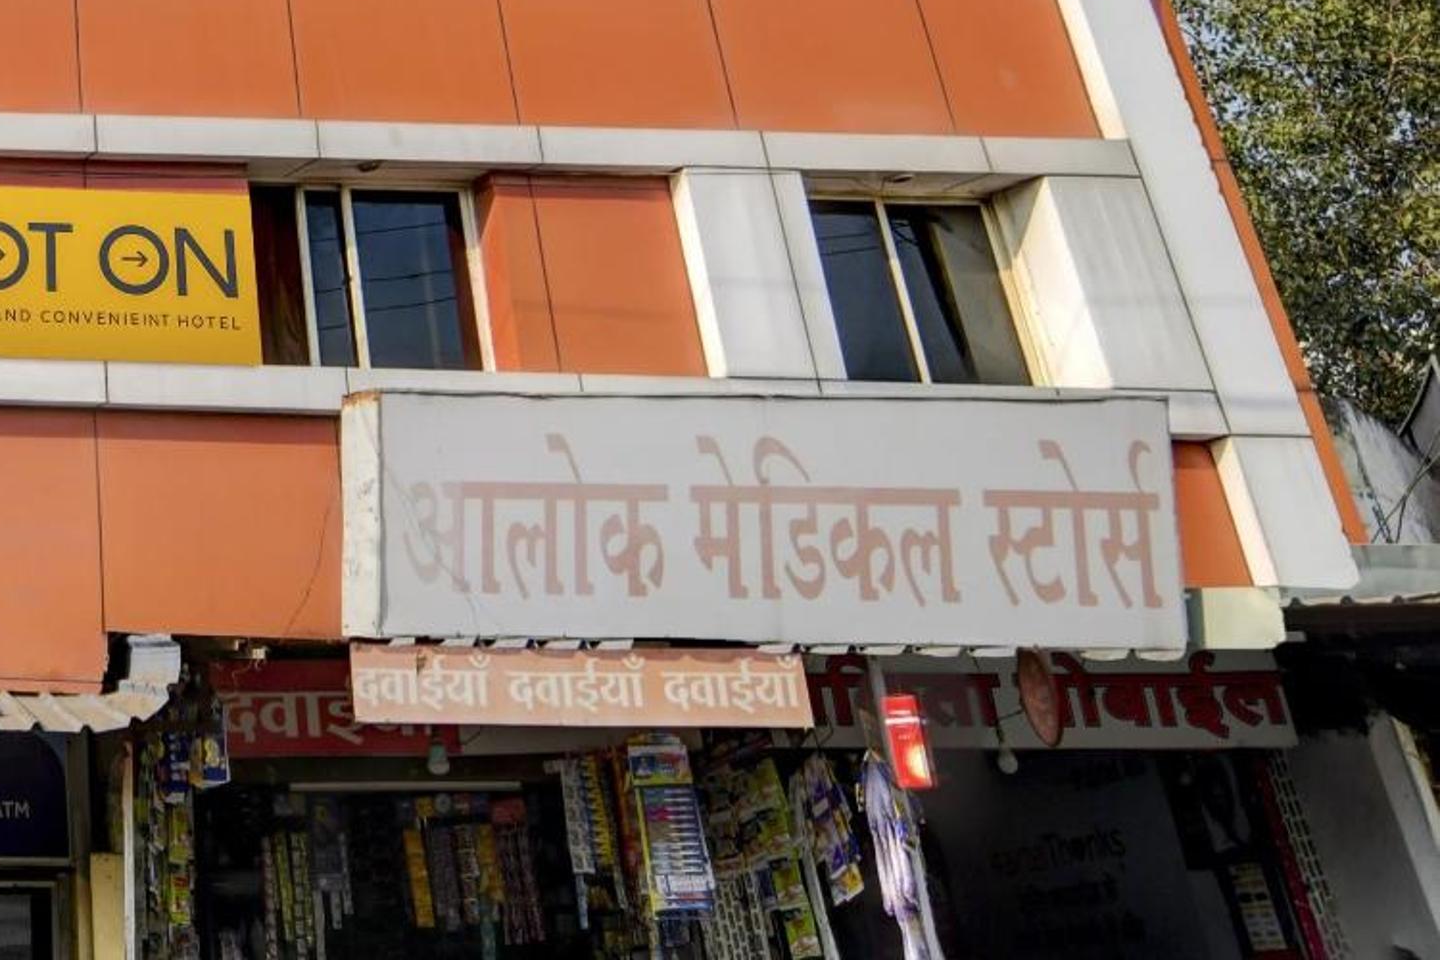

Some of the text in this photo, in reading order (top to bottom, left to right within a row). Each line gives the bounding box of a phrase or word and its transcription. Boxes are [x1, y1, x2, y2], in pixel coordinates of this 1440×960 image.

[99, 224, 240, 299] ON
[177, 314, 241, 331] HOTEL
[403, 433, 1162, 610] आलोक मेडिकल स्टोर्स
